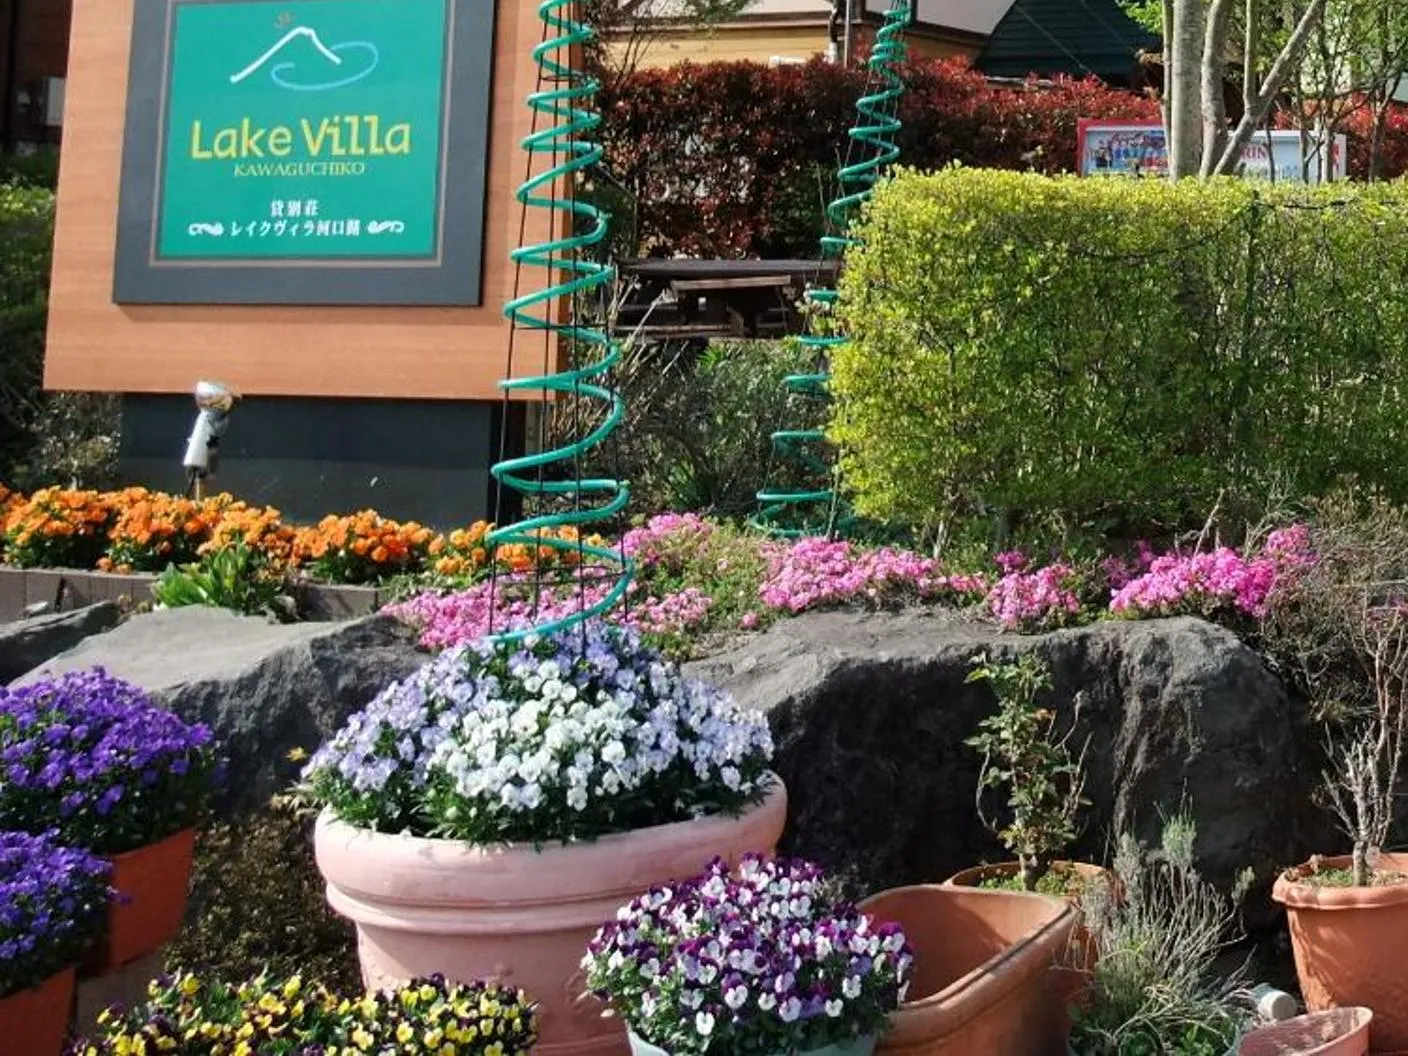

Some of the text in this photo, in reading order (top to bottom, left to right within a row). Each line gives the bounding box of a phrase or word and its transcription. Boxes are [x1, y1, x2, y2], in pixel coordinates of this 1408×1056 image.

[191, 114, 411, 160] Lake Villa
[233, 161, 366, 177] KAWAGUCHIKO
[270, 198, 319, 218] 貸別荘
[230, 218, 361, 237] レイクヴィラ河口湖
